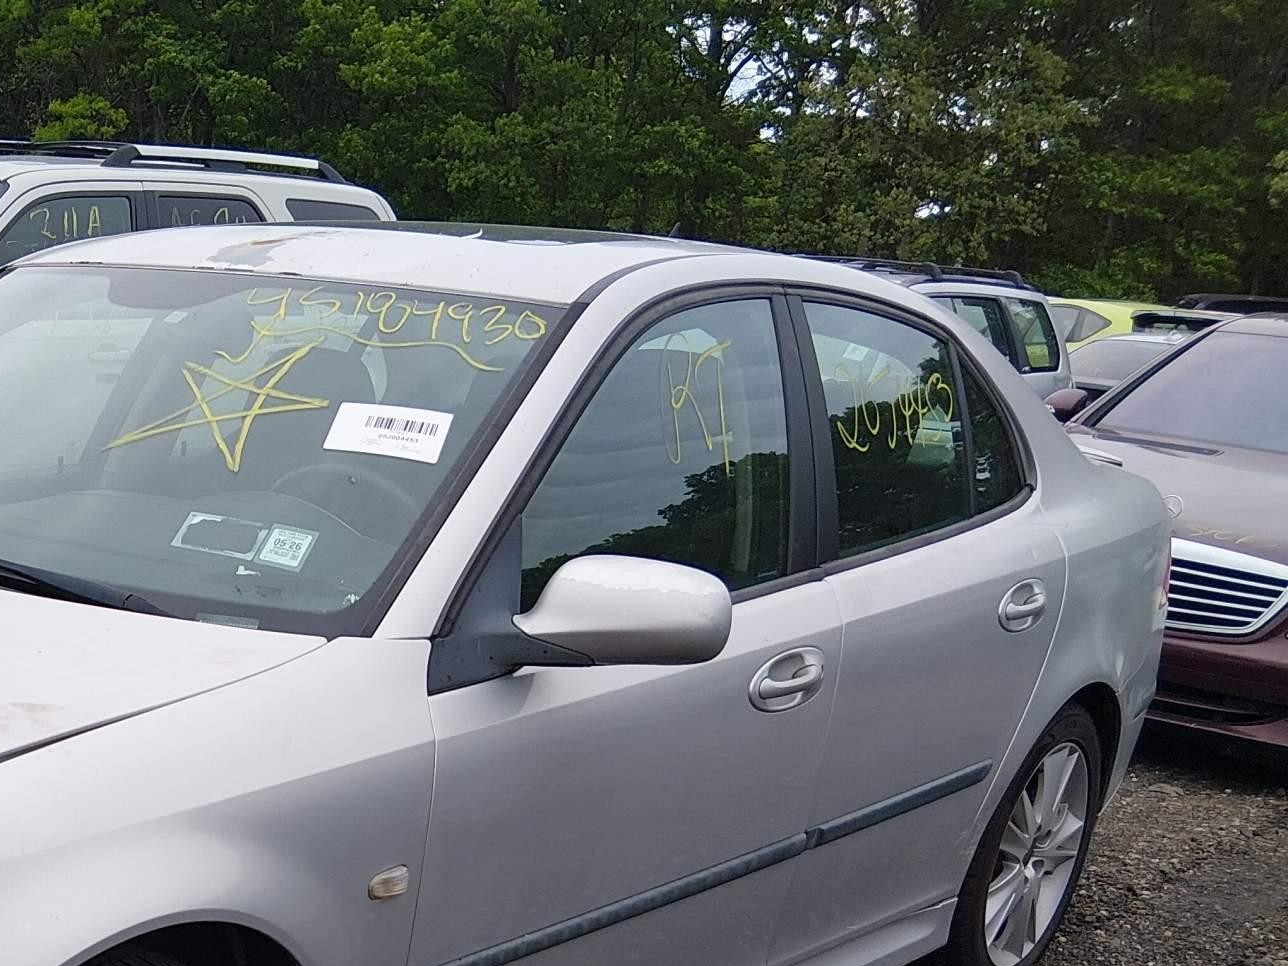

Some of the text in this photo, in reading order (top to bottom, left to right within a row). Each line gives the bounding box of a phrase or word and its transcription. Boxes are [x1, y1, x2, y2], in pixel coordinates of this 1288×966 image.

[247, 286, 546, 345] 45184930
[273, 538, 303, 551] 05 26
